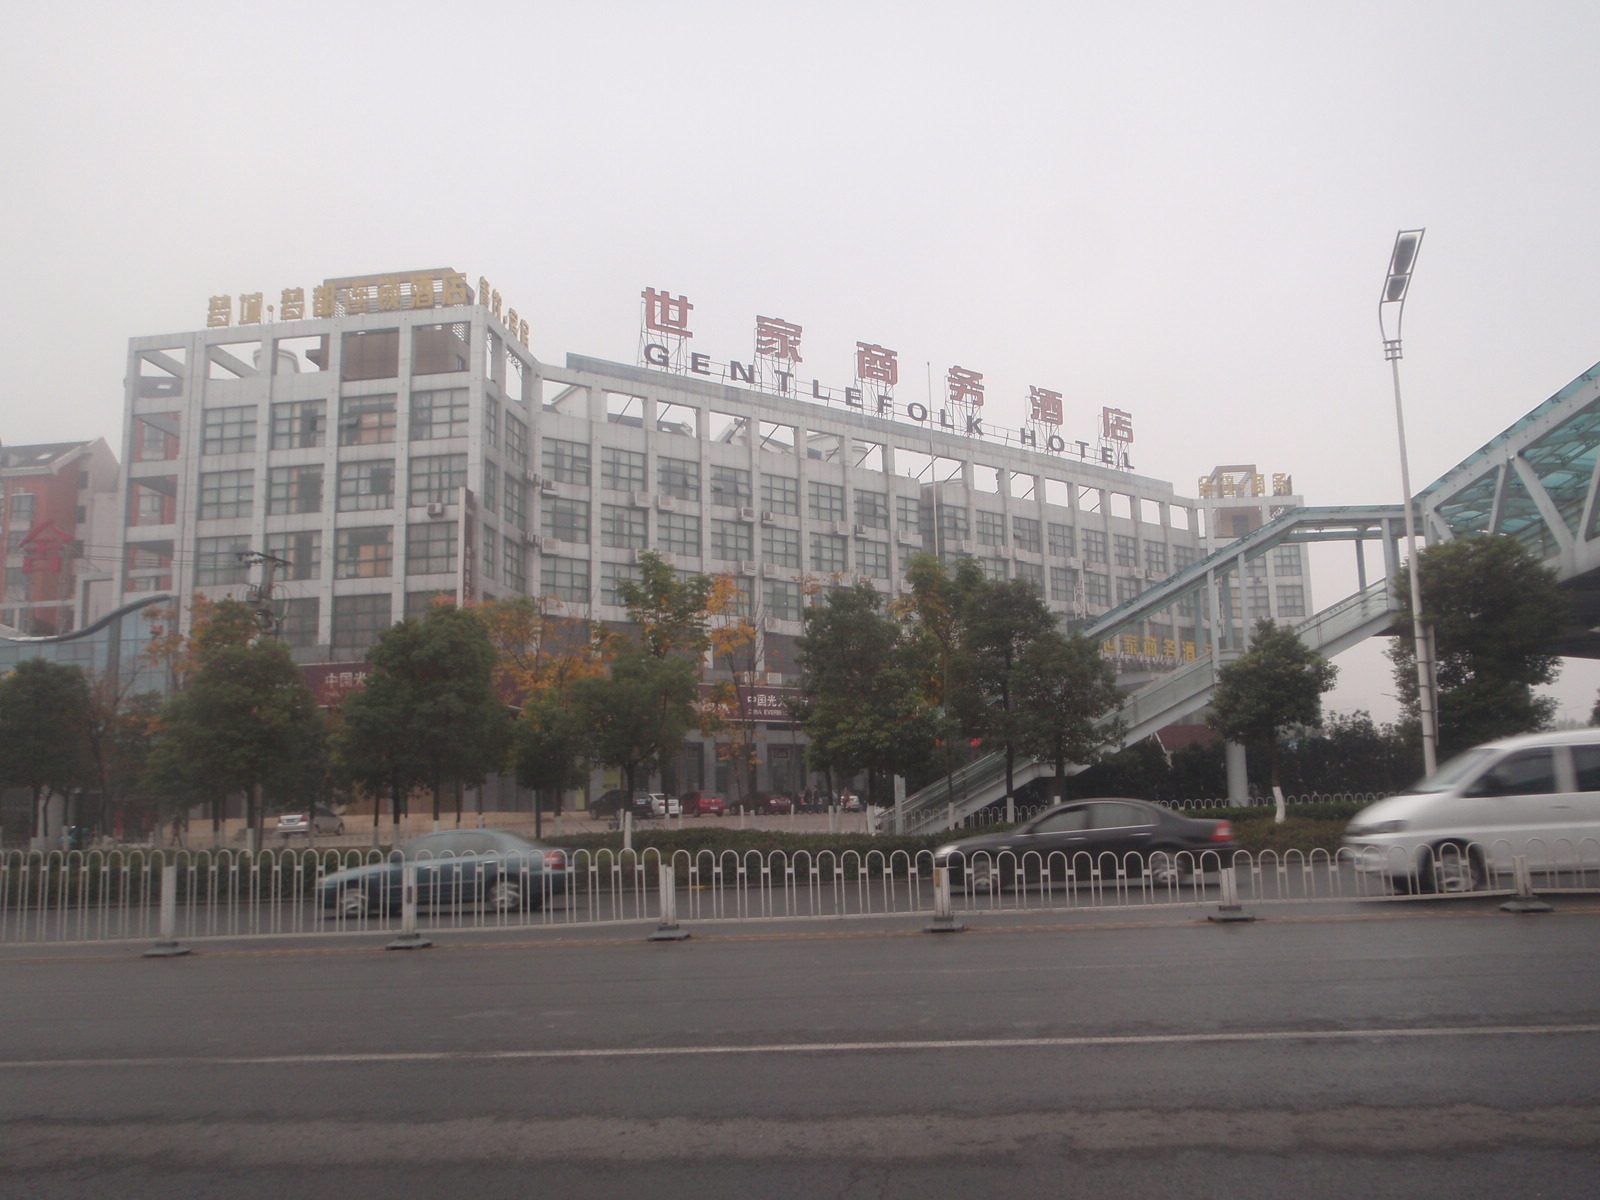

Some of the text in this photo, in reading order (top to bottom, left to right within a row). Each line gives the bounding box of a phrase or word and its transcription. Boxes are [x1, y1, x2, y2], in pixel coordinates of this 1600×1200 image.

[641, 286, 1133, 443] 世家商务酒店
[644, 343, 1135, 469] GENTLEFOLK HOTEL
